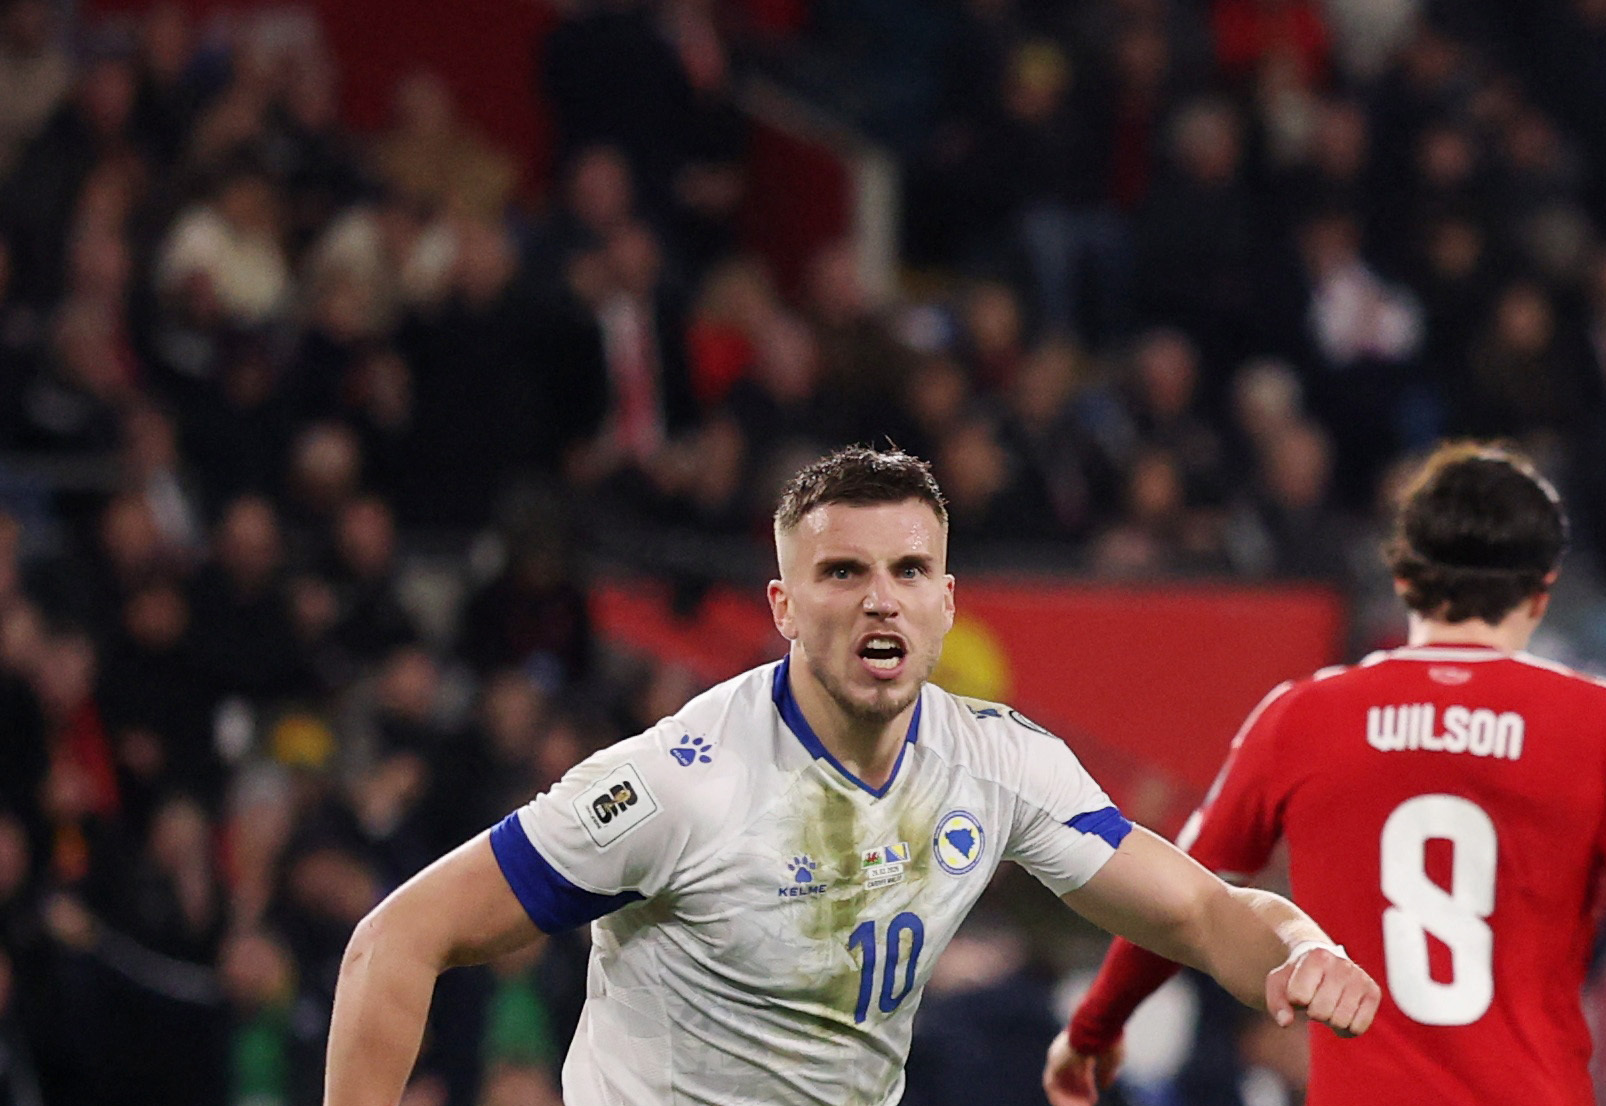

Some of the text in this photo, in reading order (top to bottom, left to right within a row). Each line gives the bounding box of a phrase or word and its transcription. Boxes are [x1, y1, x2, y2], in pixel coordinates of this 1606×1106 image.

[1366, 702, 1525, 761] WILSON
[778, 884, 827, 897] KELME
[1380, 793, 1498, 1026] 8
[847, 911, 925, 1024] 10
